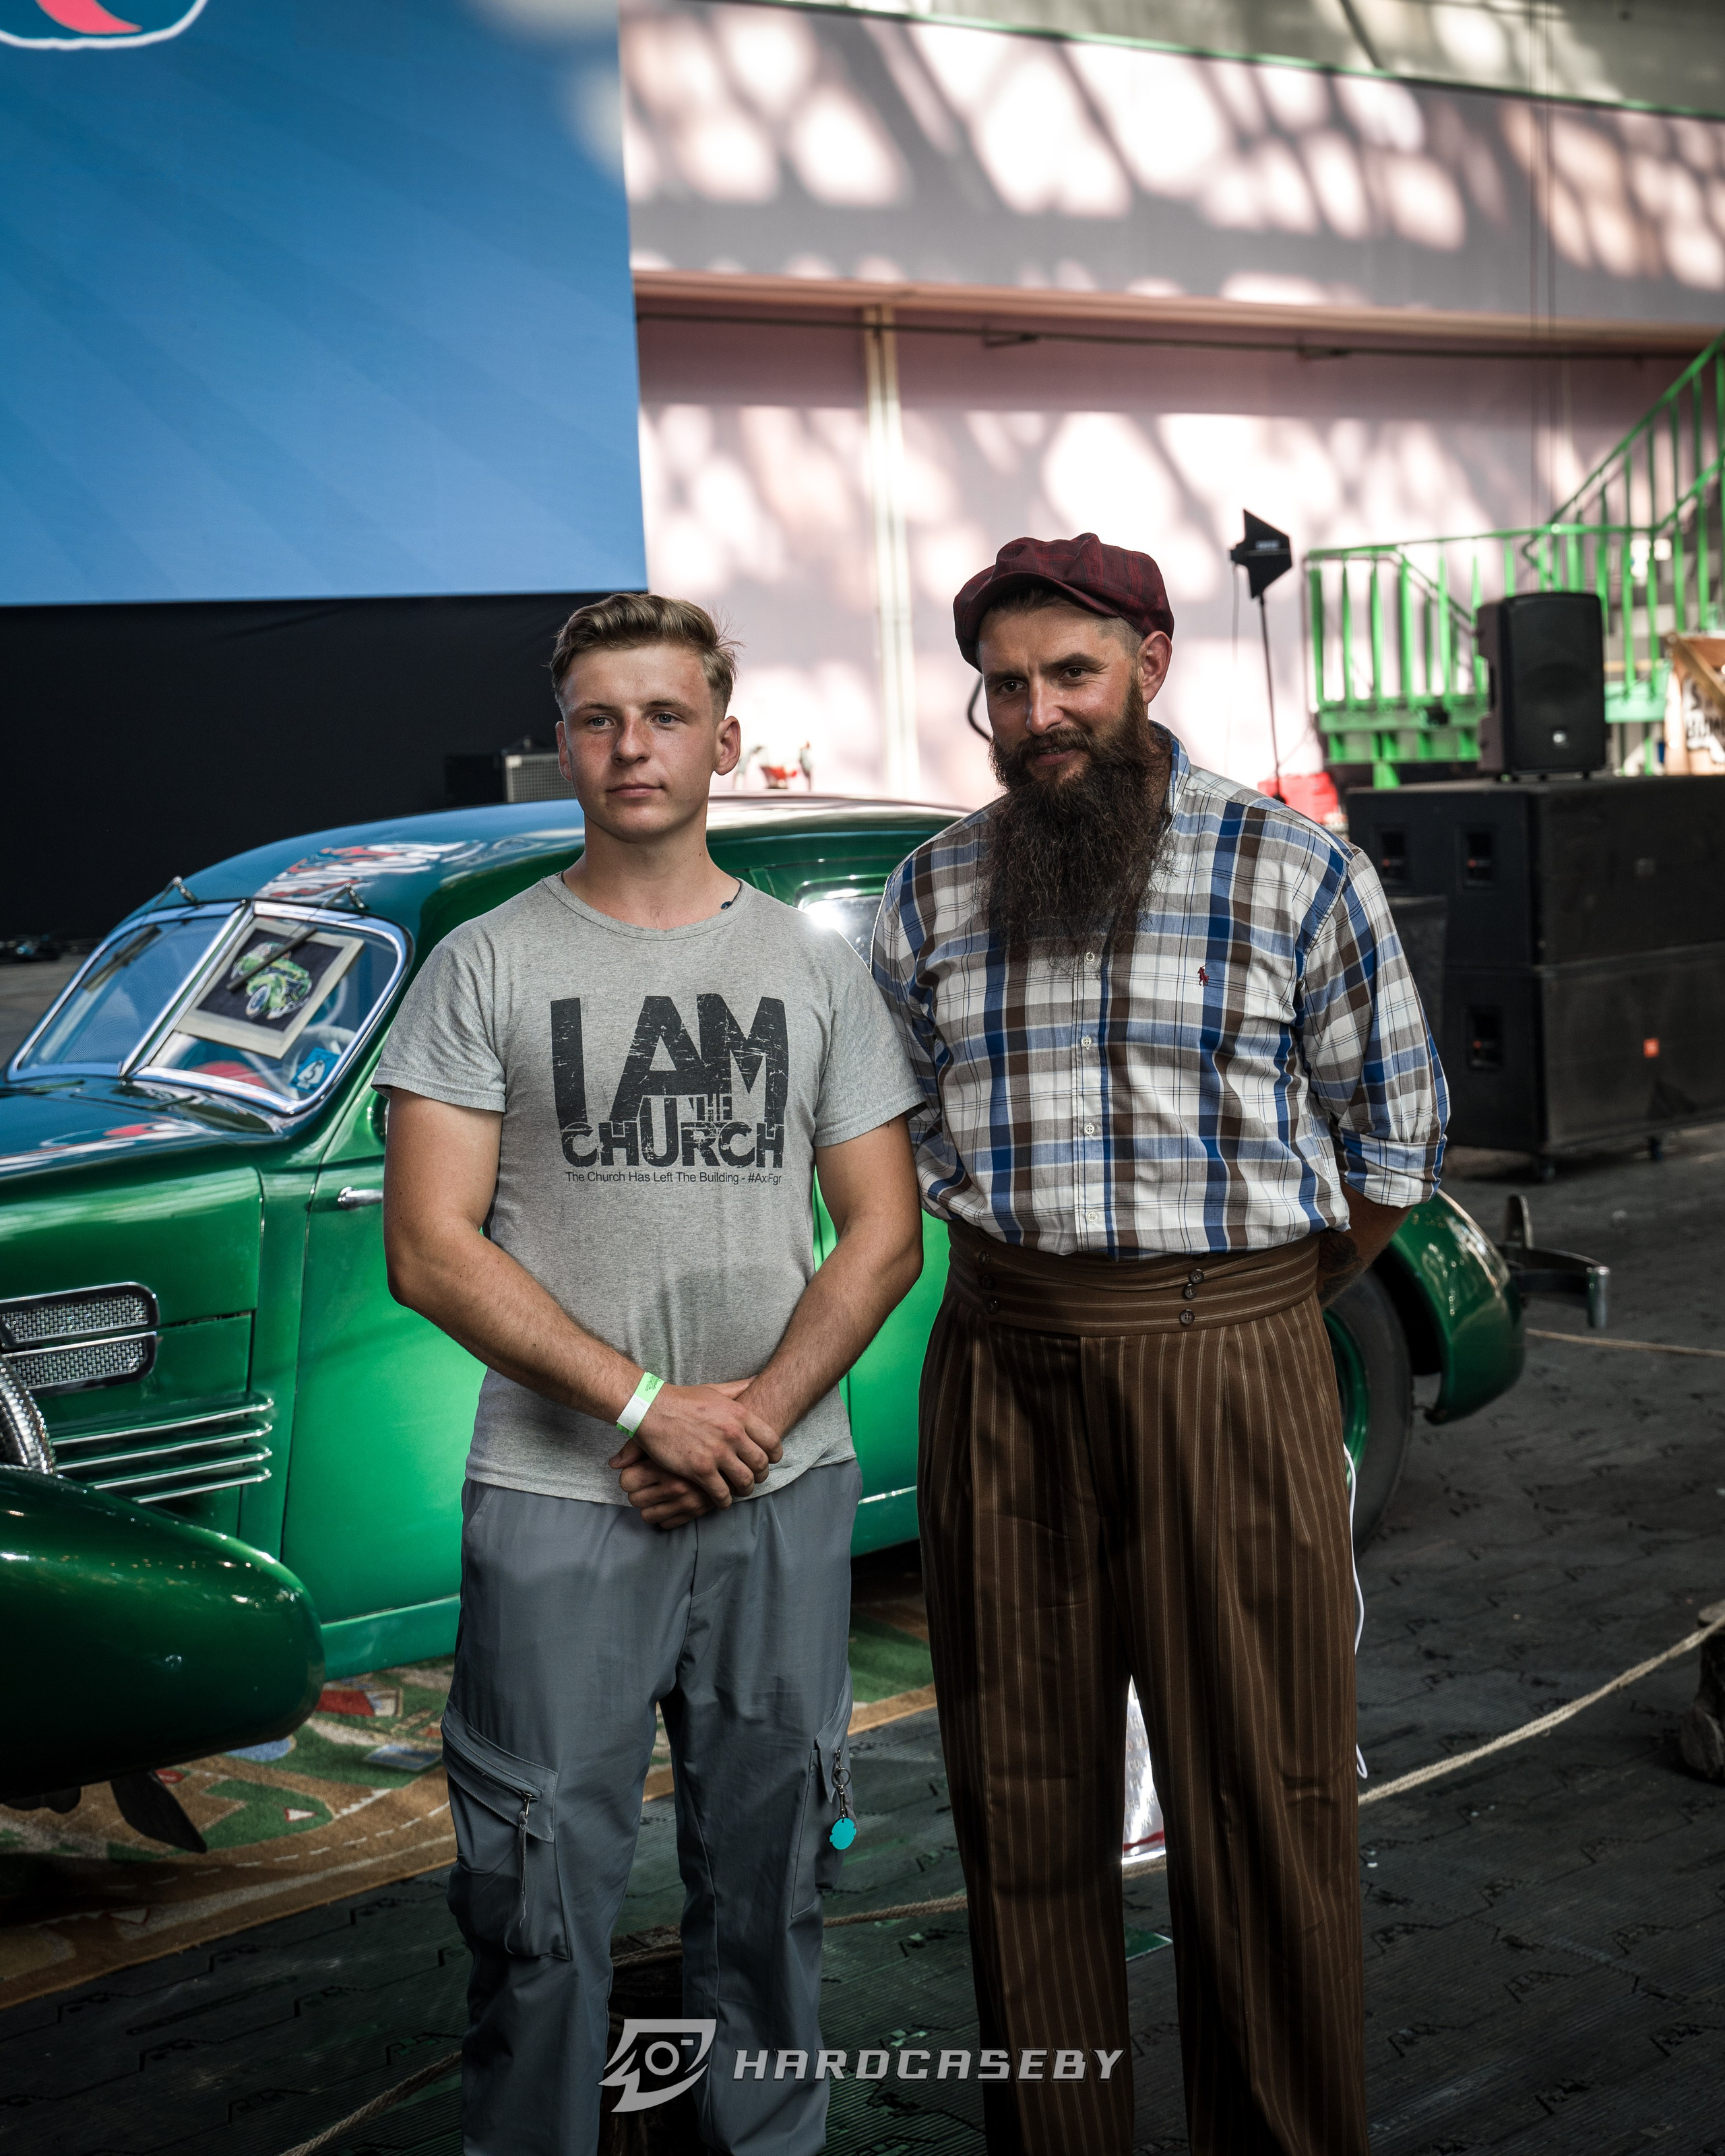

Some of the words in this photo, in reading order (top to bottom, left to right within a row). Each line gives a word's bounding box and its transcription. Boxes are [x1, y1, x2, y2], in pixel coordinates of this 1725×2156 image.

[550, 997, 588, 1129] I
[608, 992, 789, 1124] AM
[561, 1096, 784, 1168] CHURCH
[682, 1093, 732, 1122] THE
[565, 1171, 585, 1182] The
[587, 1171, 626, 1182] Church
[629, 1171, 651, 1182] Has
[654, 1172, 674, 1182] Left
[676, 1172, 697, 1182] The
[699, 1172, 739, 1185] Building
